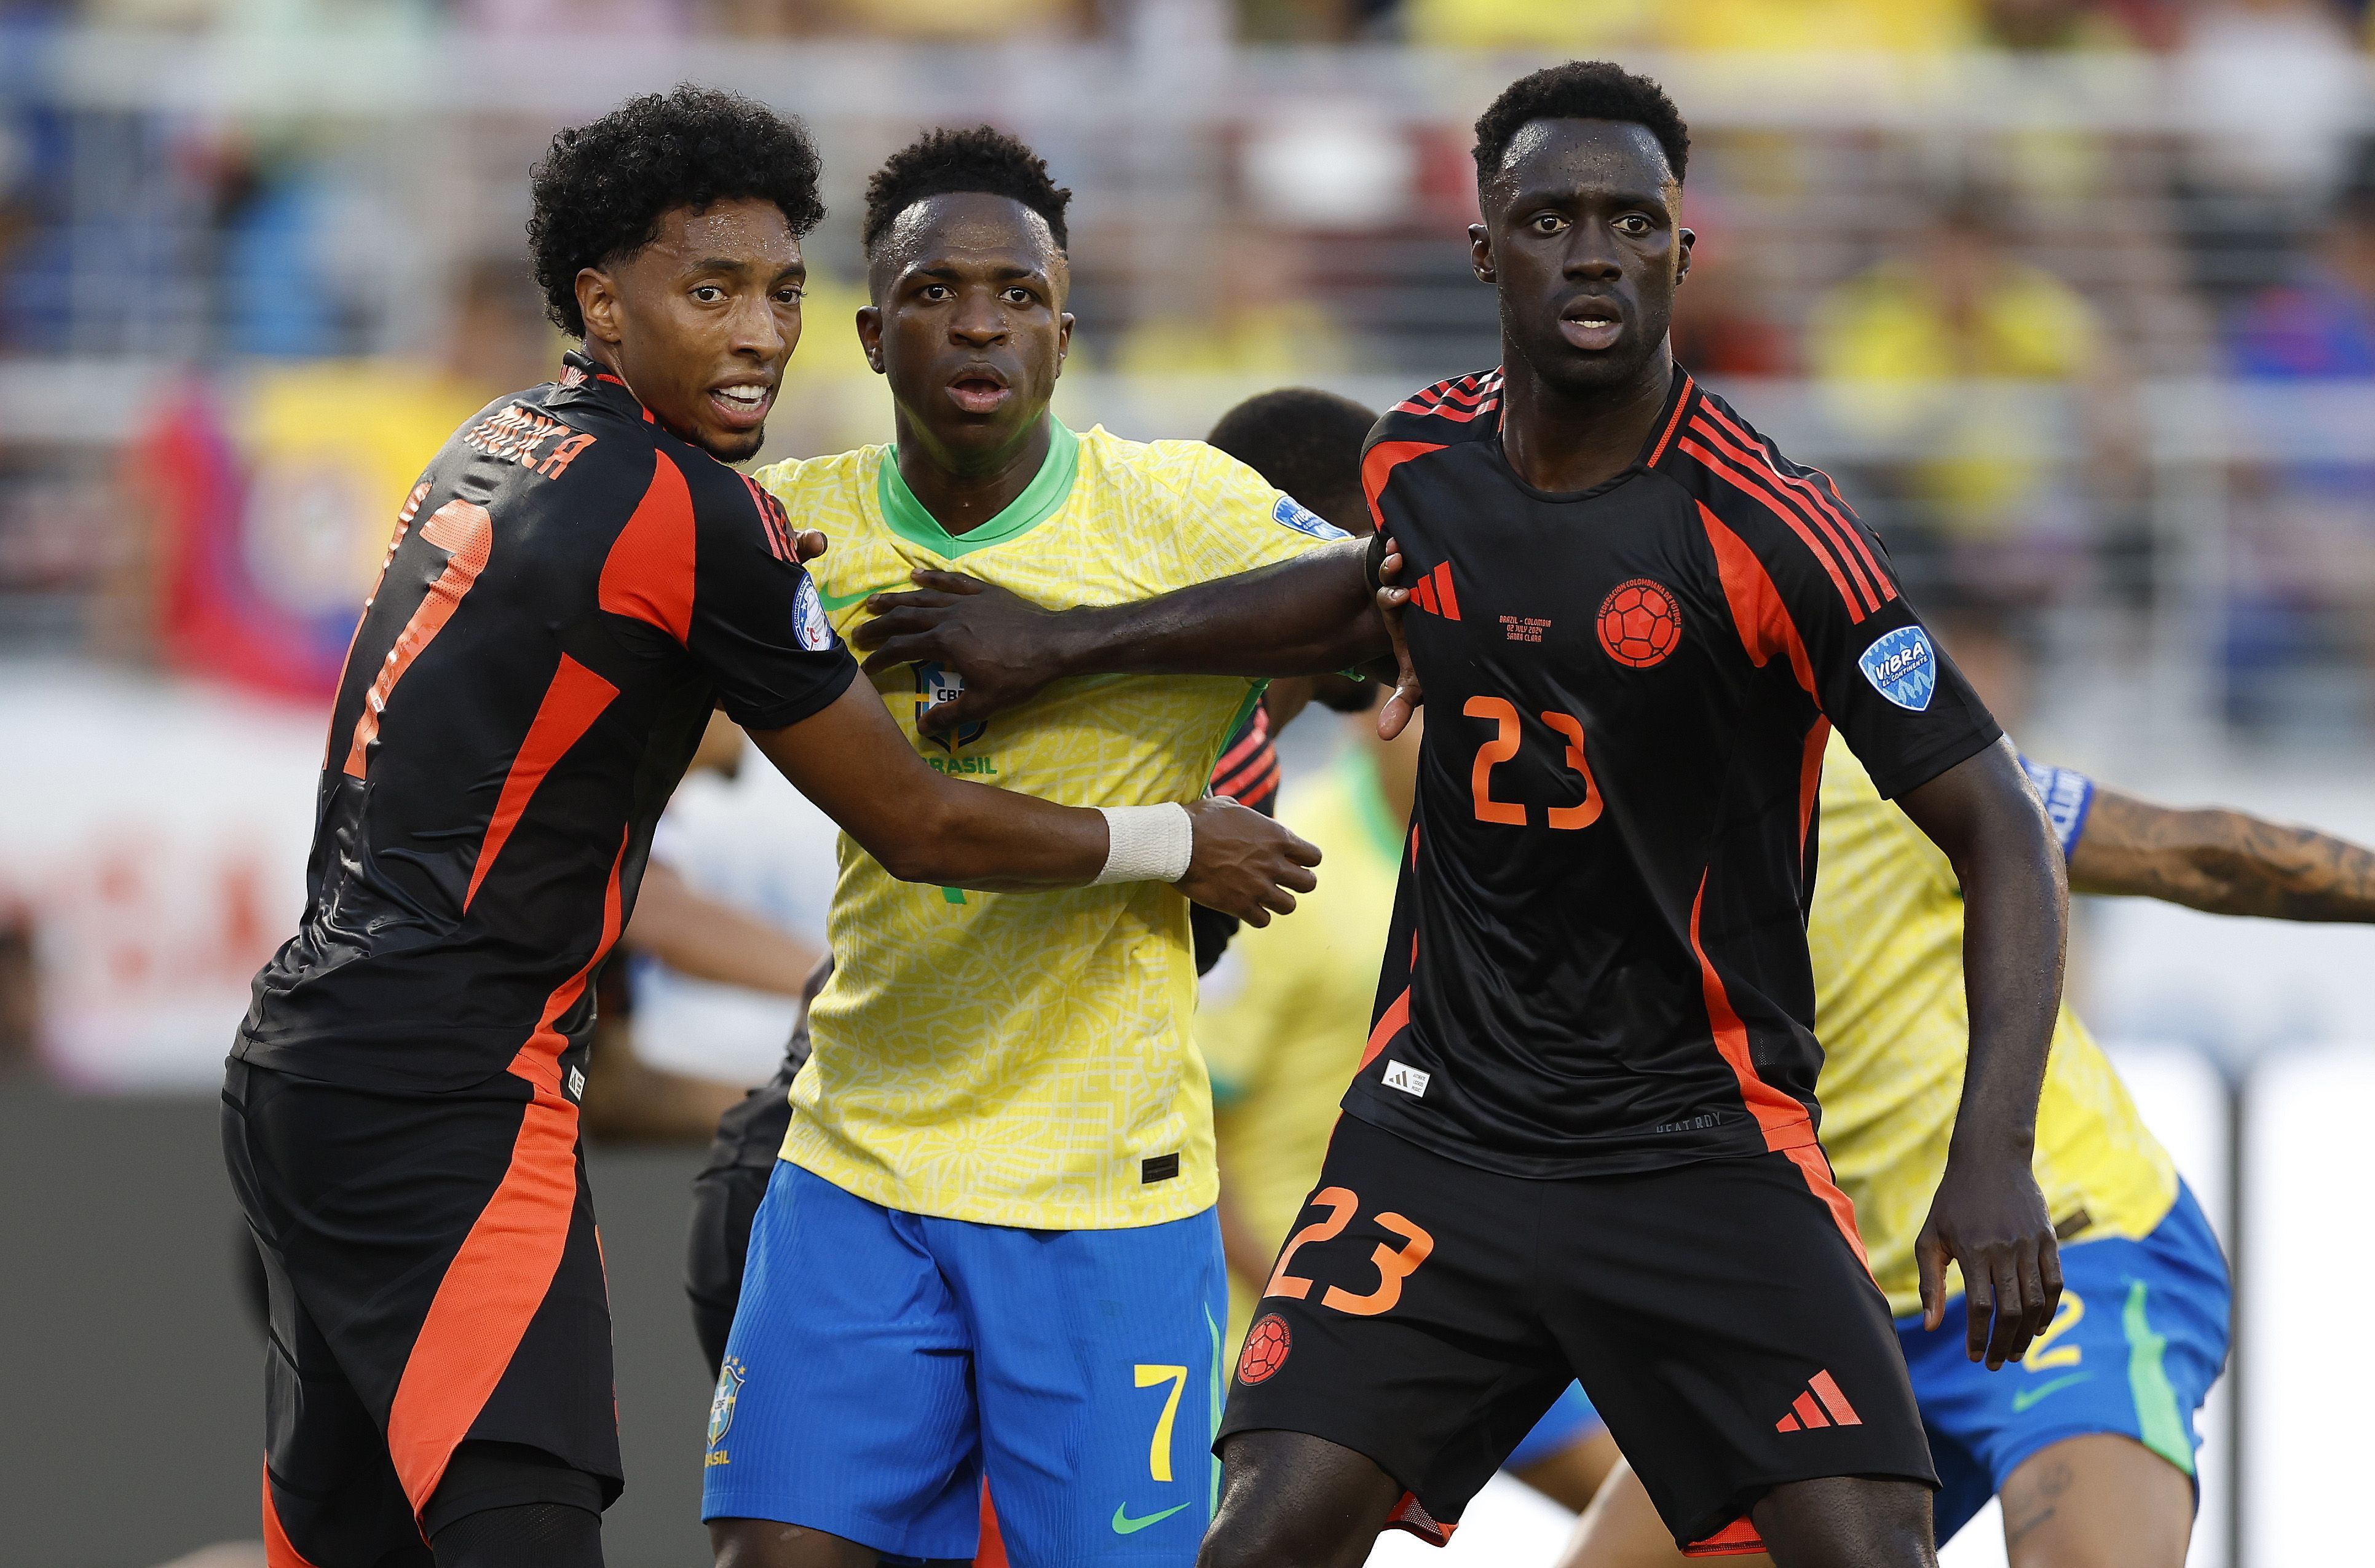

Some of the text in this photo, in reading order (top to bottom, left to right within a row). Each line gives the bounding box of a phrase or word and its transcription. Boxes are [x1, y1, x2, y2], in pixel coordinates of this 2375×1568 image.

[1499, 615, 1518, 624] BRAZIL
[1525, 618, 1552, 627] COLOMBIA
[1875, 642, 1925, 680] VIBRA
[1882, 656, 1928, 687] EL CONTINENTE
[923, 757, 997, 774] RASIL
[1463, 695, 1604, 830] 23
[1263, 1186, 1434, 1315] 23
[2021, 1288, 2085, 1373] 2
[1134, 1364, 1188, 1481] 7
